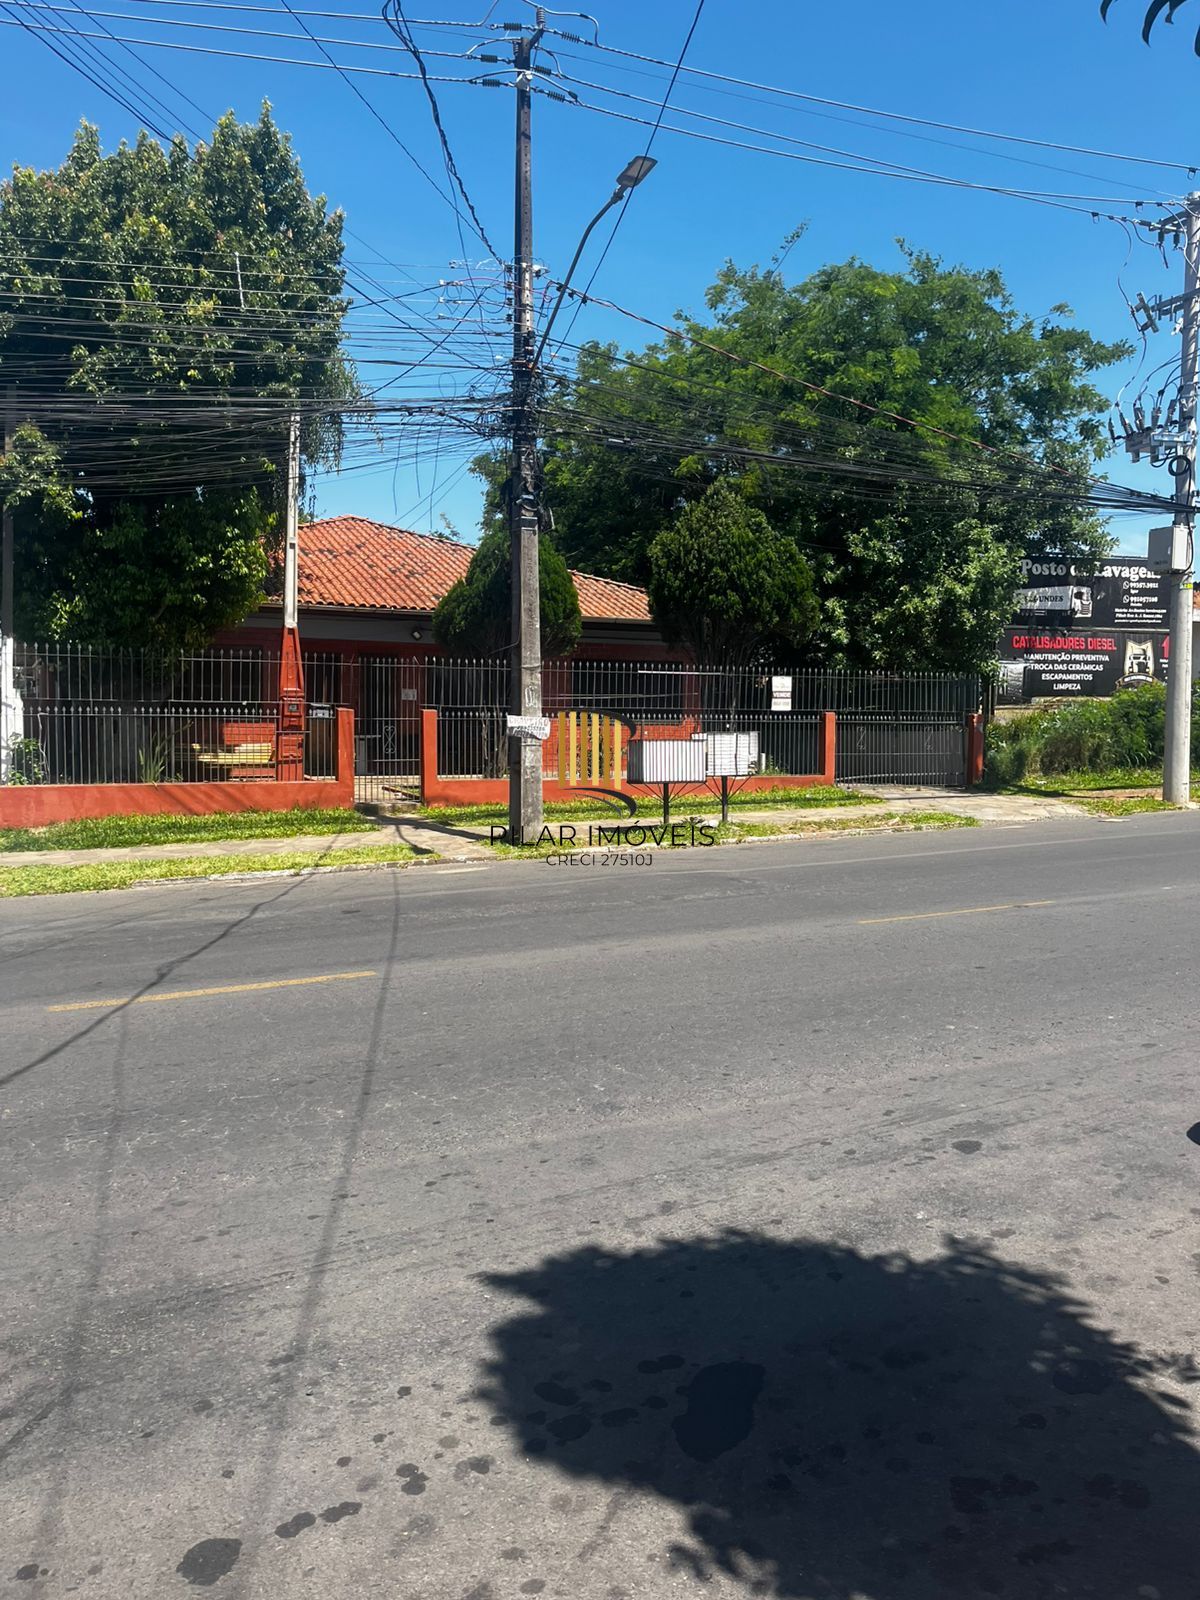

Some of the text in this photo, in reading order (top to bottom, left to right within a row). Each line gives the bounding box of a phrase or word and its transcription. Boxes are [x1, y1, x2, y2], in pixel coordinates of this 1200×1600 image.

[1022, 559, 1067, 576] Posto
[1012, 635, 1117, 650] CATALISADORES DIESEL
[1024, 652, 1110, 662] MANUTENÇÃO PREVENTIVA
[1029, 663, 1053, 671] TROCA
[1068, 663, 1104, 671] CERÂMICAS
[1041, 673, 1094, 681] ESCAPAMENTOS
[1053, 683, 1081, 691] LIMPEZA
